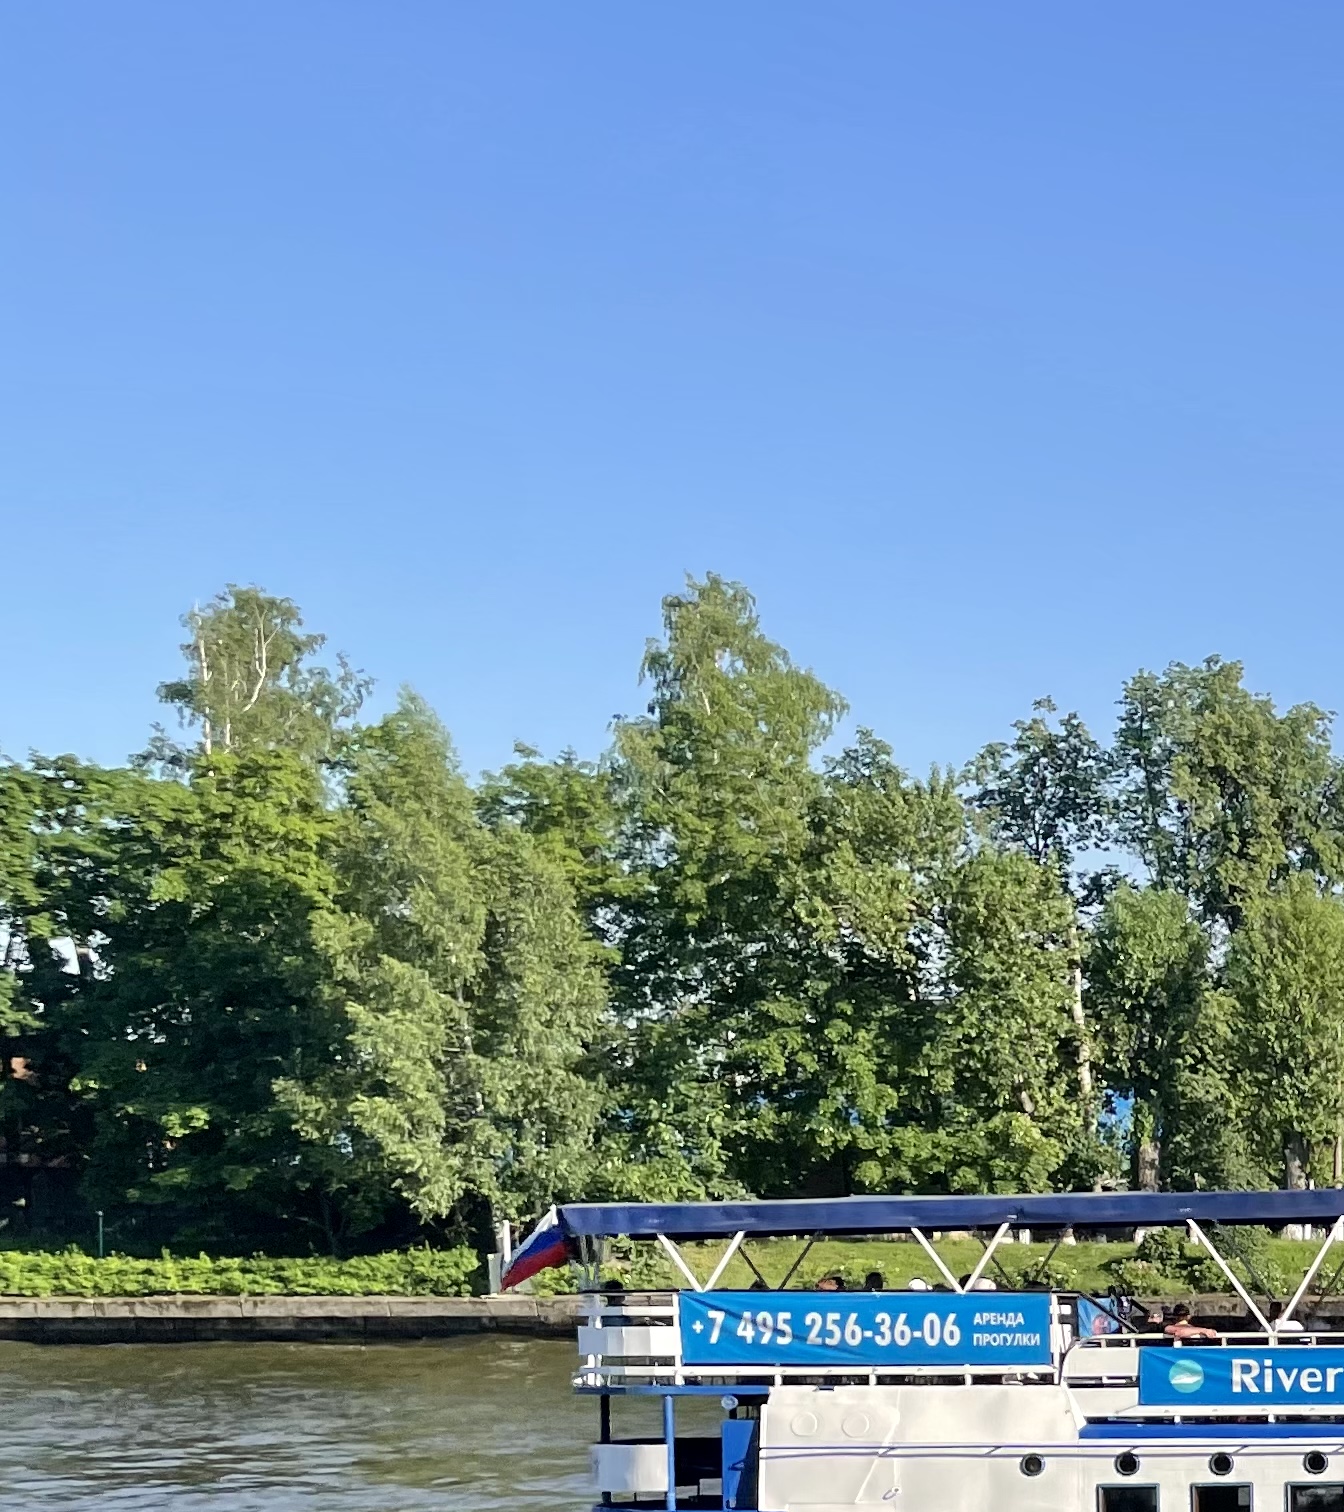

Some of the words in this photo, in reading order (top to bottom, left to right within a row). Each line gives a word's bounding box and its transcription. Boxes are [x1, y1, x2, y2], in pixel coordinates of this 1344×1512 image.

[973, 1312, 1025, 1328] АРЕНДА
[692, 1310, 725, 1345] +7
[736, 1311, 793, 1345] 495
[805, 1312, 962, 1347] 256-36-06
[973, 1332, 1041, 1347] ПРОГУЛКИ
